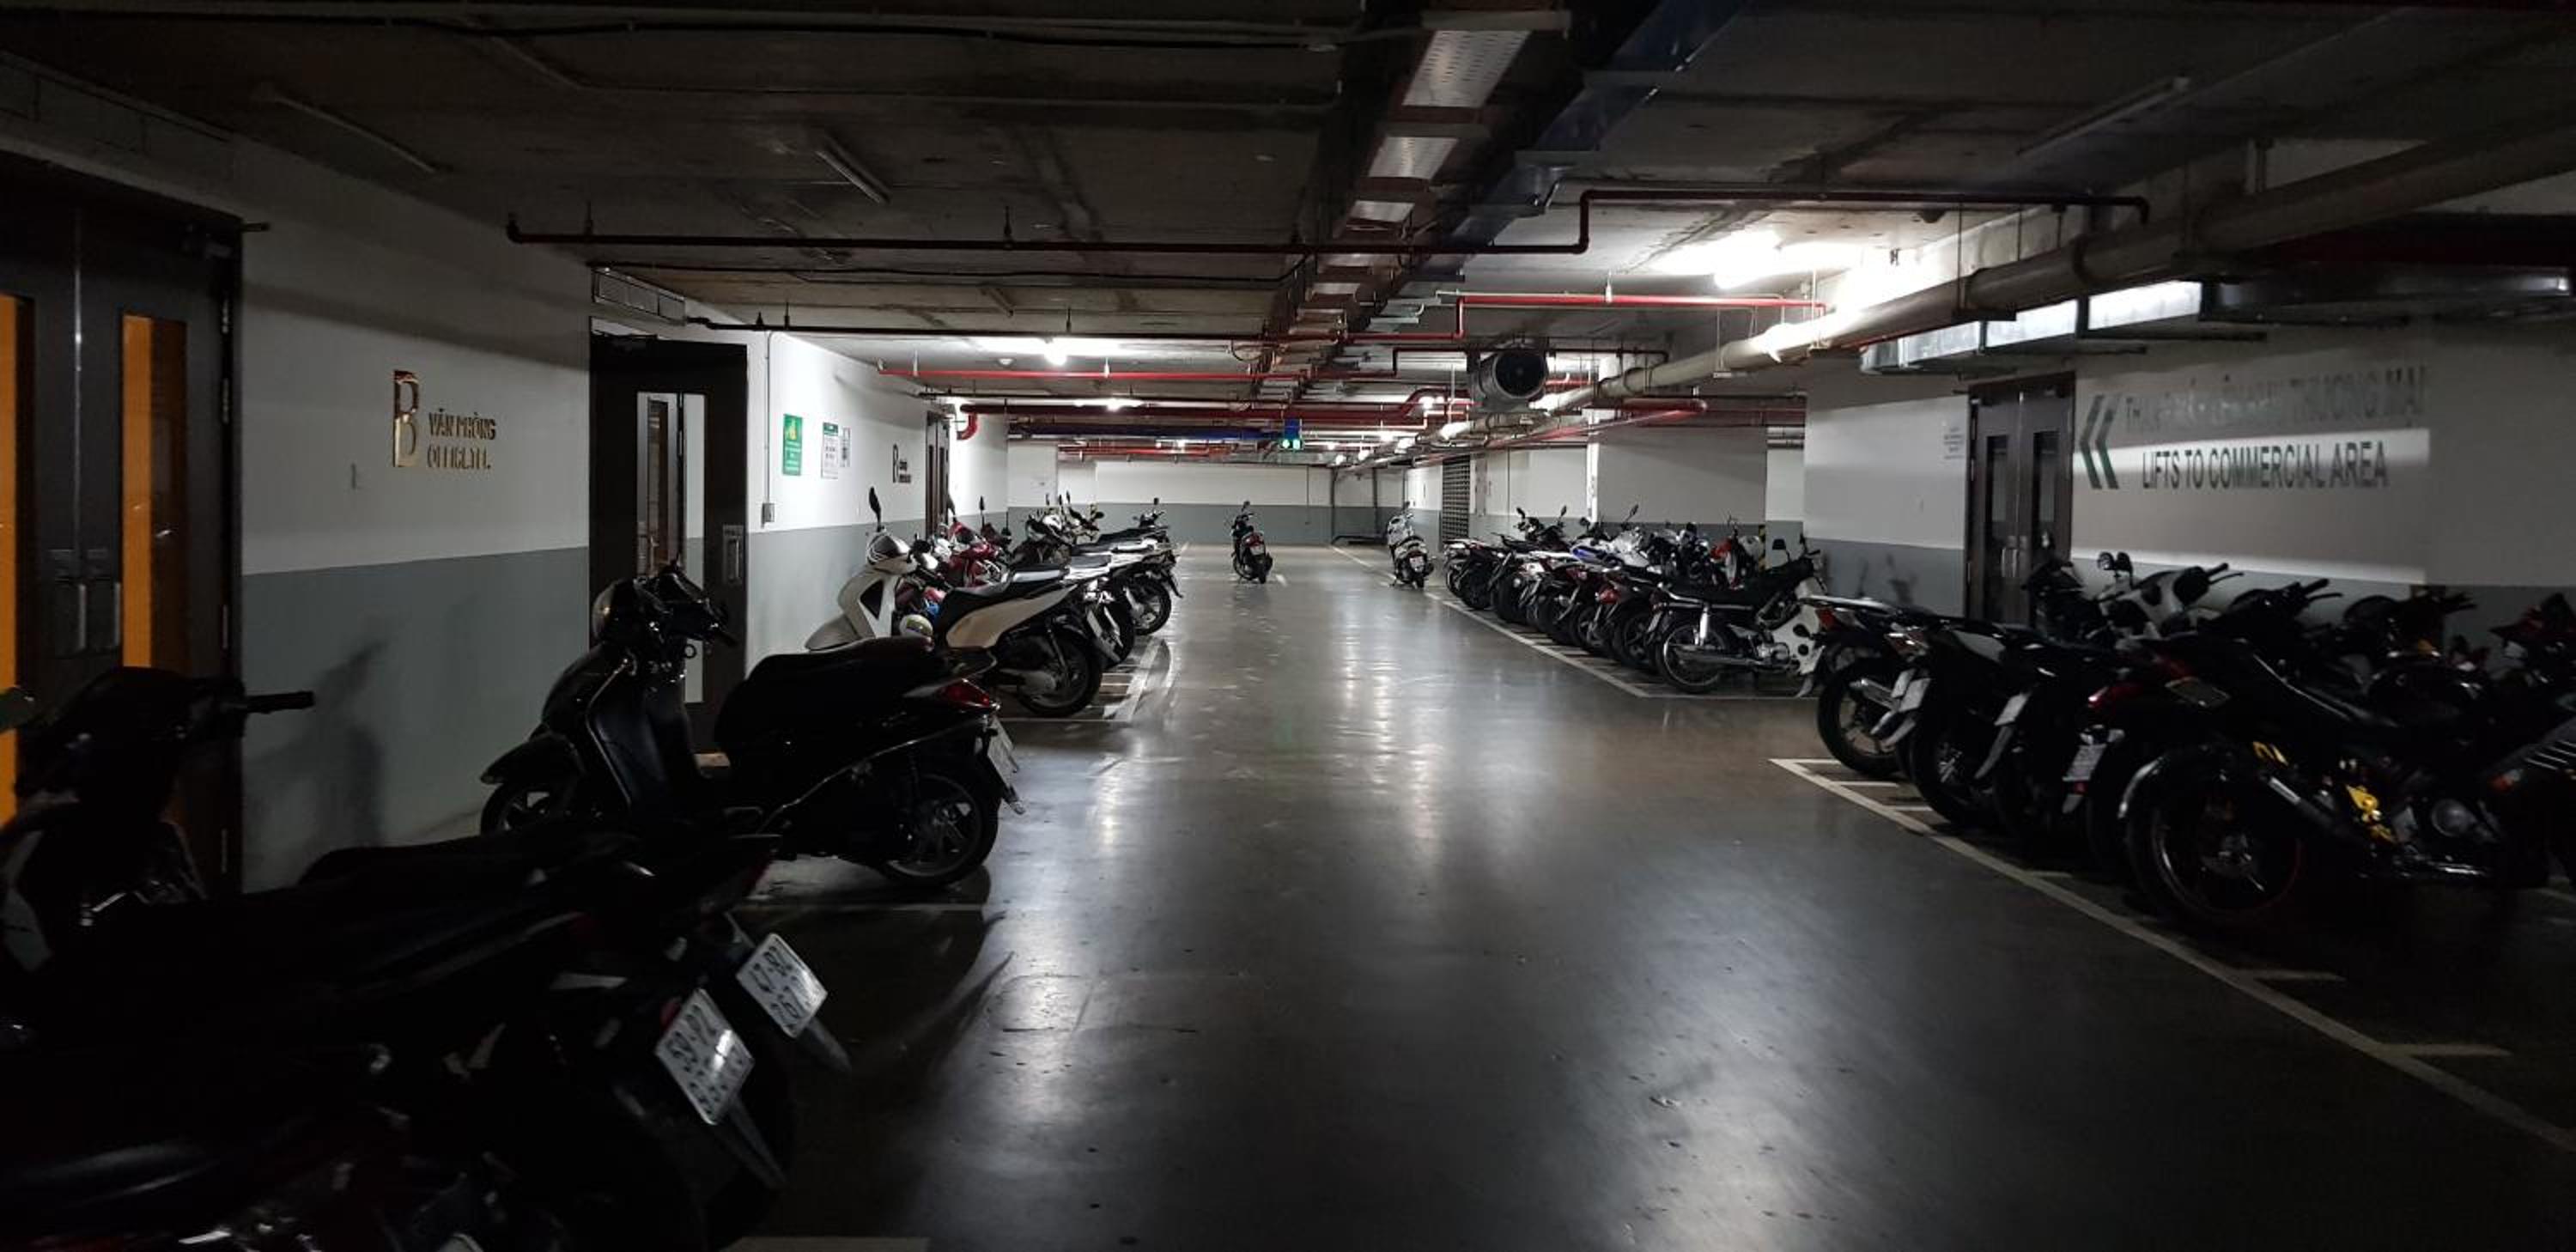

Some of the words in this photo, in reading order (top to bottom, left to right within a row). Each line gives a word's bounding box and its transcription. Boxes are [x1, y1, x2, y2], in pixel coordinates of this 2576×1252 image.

[392, 369, 419, 468] B
[2142, 450, 2181, 489] LIFTS
[2184, 448, 2204, 489] TO
[2208, 443, 2325, 489] COMMERCIAL
[2328, 440, 2389, 489] AREA
